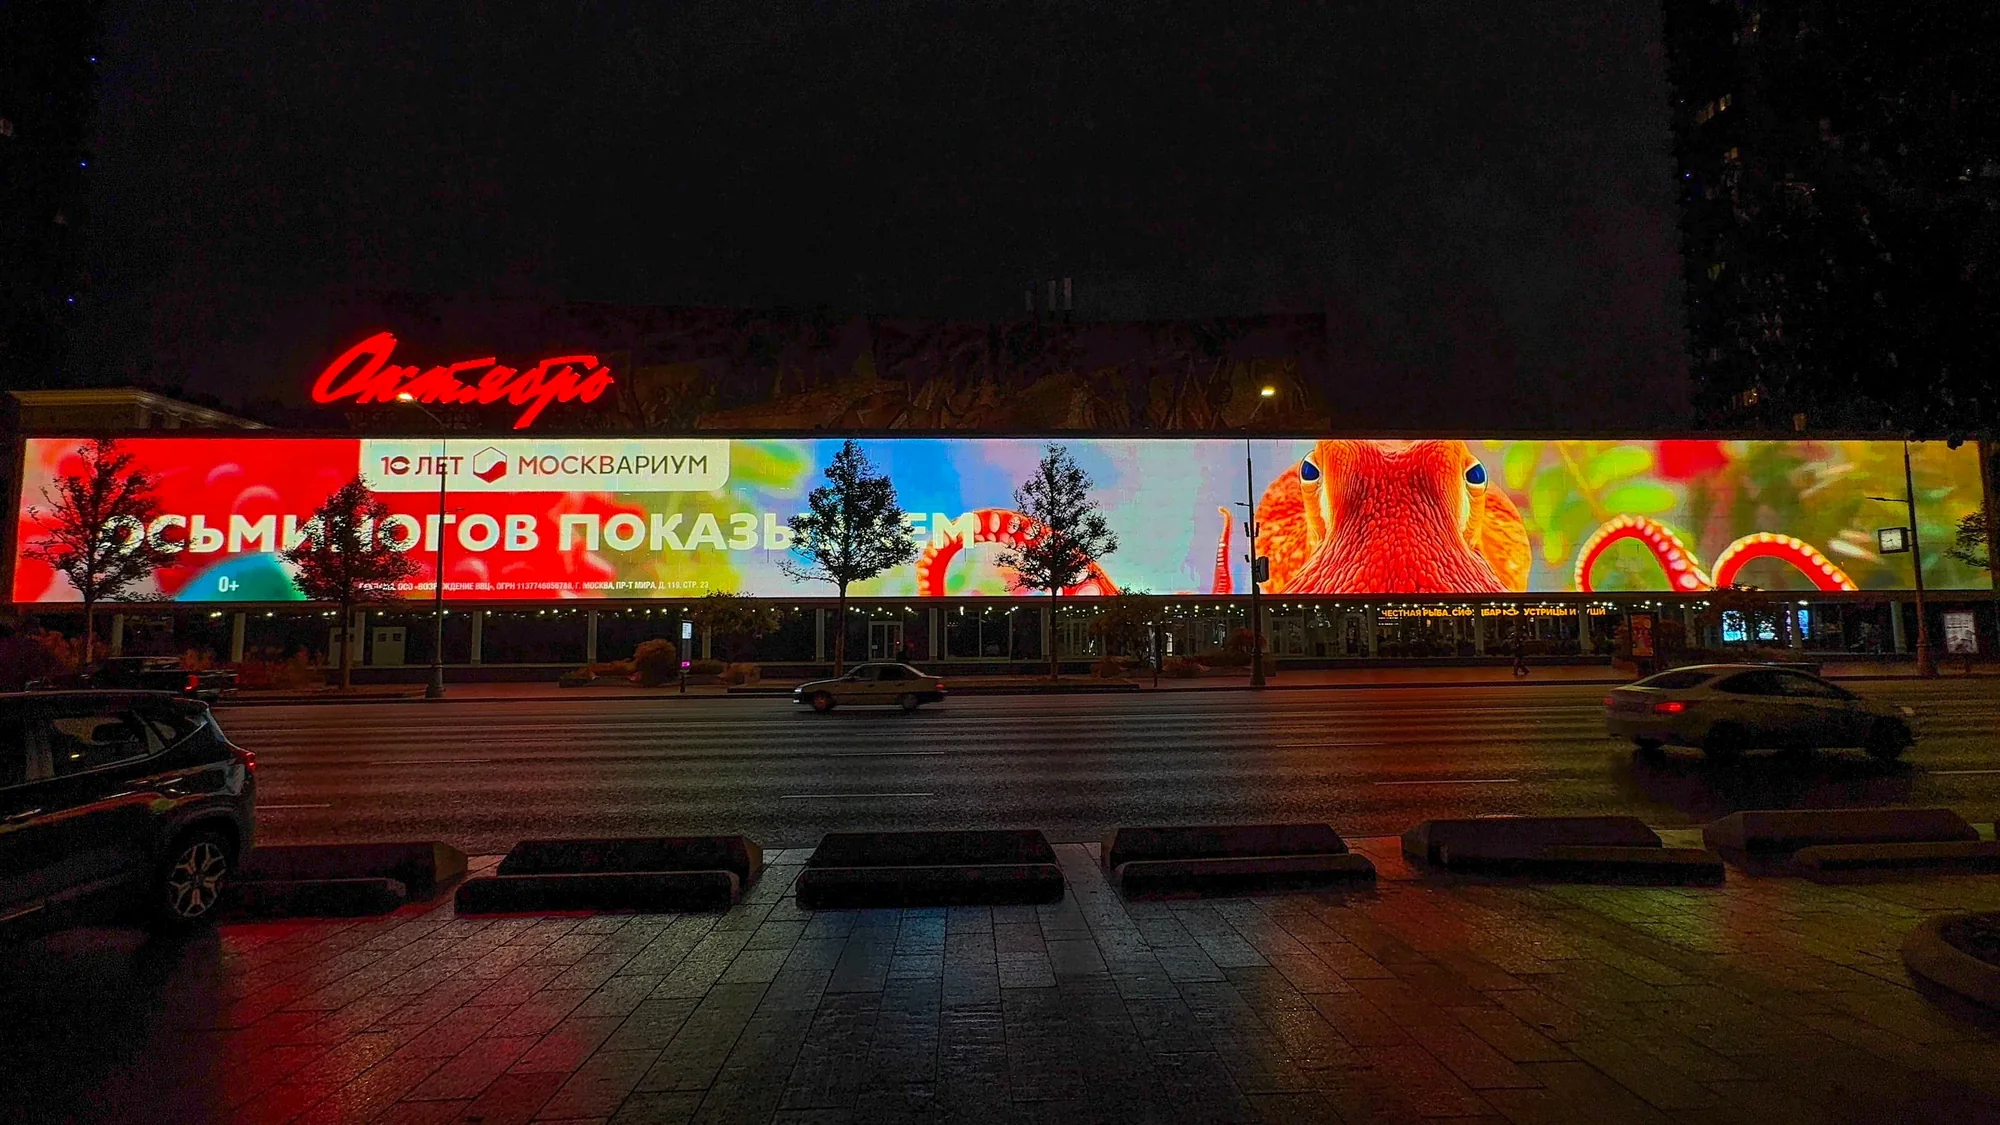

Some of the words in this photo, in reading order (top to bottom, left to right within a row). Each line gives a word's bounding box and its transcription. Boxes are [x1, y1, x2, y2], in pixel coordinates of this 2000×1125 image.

[312, 331, 614, 430] Октябрь
[414, 456, 464, 475] ЛЕТ
[517, 455, 708, 475] МОСКВАРИУМ
[559, 512, 977, 551] ПОКАЗЫЕМ
[218, 576, 240, 593] 0+
[414, 582, 475, 592] «ВОЗРЖДЕНИЕ
[583, 581, 615, 591] МОСКВА,
[1381, 609, 1421, 617] ЧЕСТНАЯ
[1524, 607, 1568, 617] УСТРИЦЫ
[1569, 607, 1577, 616] И
